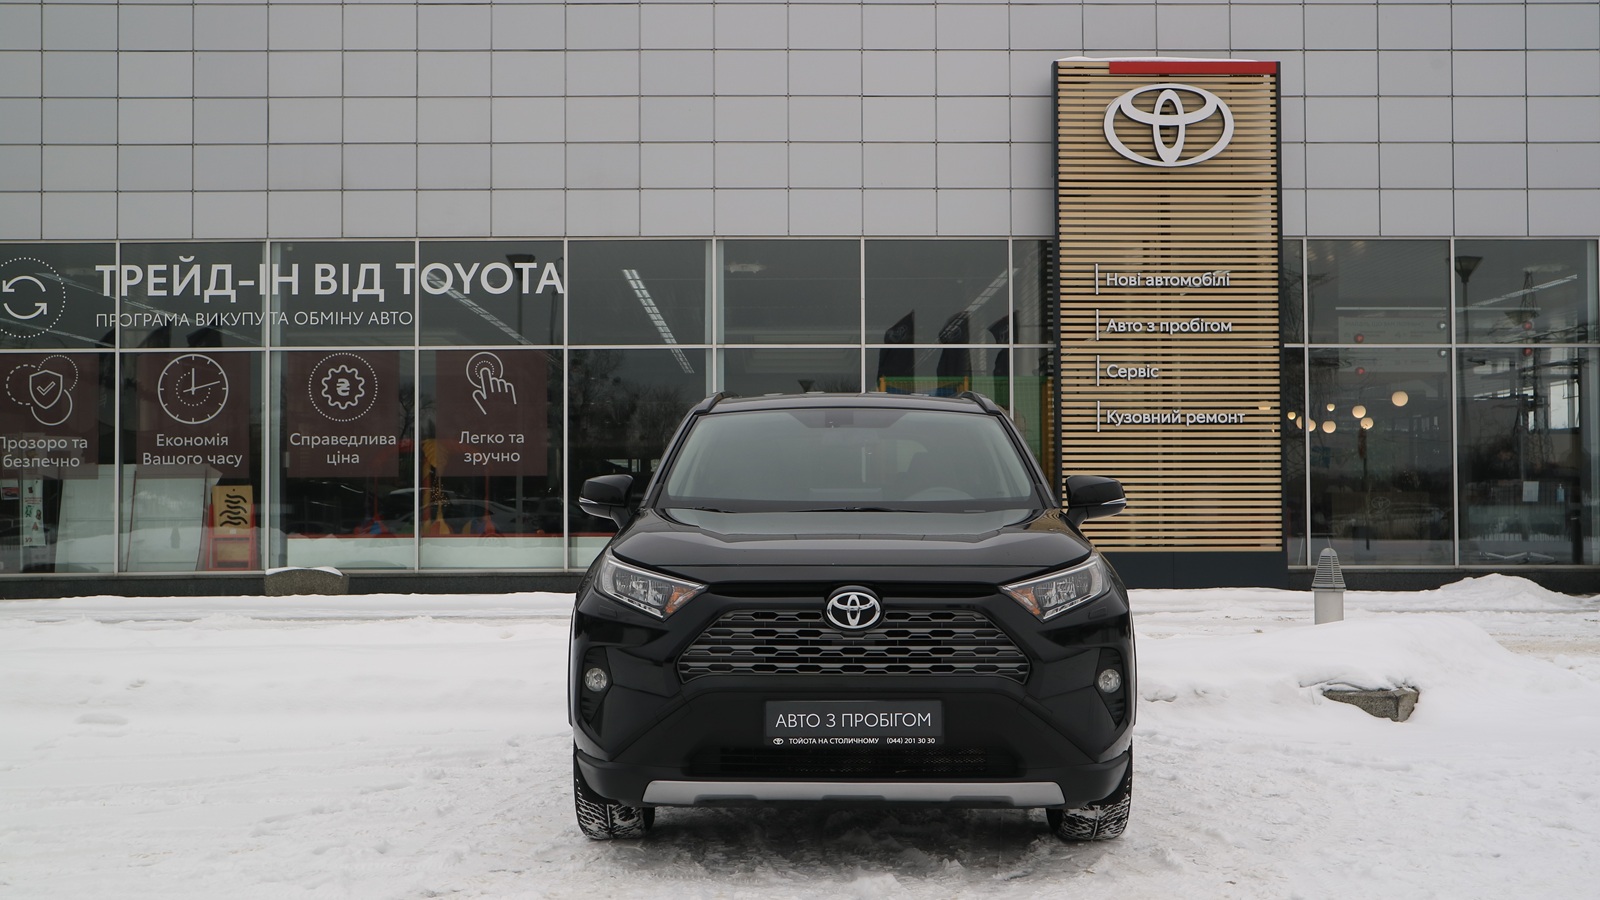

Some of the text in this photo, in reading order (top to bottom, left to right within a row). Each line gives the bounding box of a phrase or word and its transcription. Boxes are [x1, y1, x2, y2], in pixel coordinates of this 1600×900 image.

[95, 256, 565, 303] ТРЕЙД-ІН ВІД TOYOTA
[1106, 272, 1230, 287] Нові автомобілі
[96, 311, 413, 327] ПРОГРАМА ВИКУПУ ТА ОБМІНУ АВТО
[1106, 317, 1233, 335] Авто з пробігом
[1106, 364, 1160, 381] Сервіс
[1106, 409, 1246, 427] Кузовний ремонт
[71, 438, 88, 449] та
[156, 433, 229, 447] Економія
[289, 433, 397, 448] Справедлива
[459, 430, 525, 444] Легко та
[3, 454, 80, 468] безпечно
[142, 452, 243, 467] Вашого часу
[326, 450, 360, 465] ціна
[464, 449, 521, 465] зручно
[775, 713, 821, 728] АВТО
[841, 712, 932, 728] ПРОБІГОМ
[788, 737, 817, 745] ТОЙОТА
[829, 737, 880, 745] СТОЛИЧНОМУ
[886, 737, 903, 745] (044)
